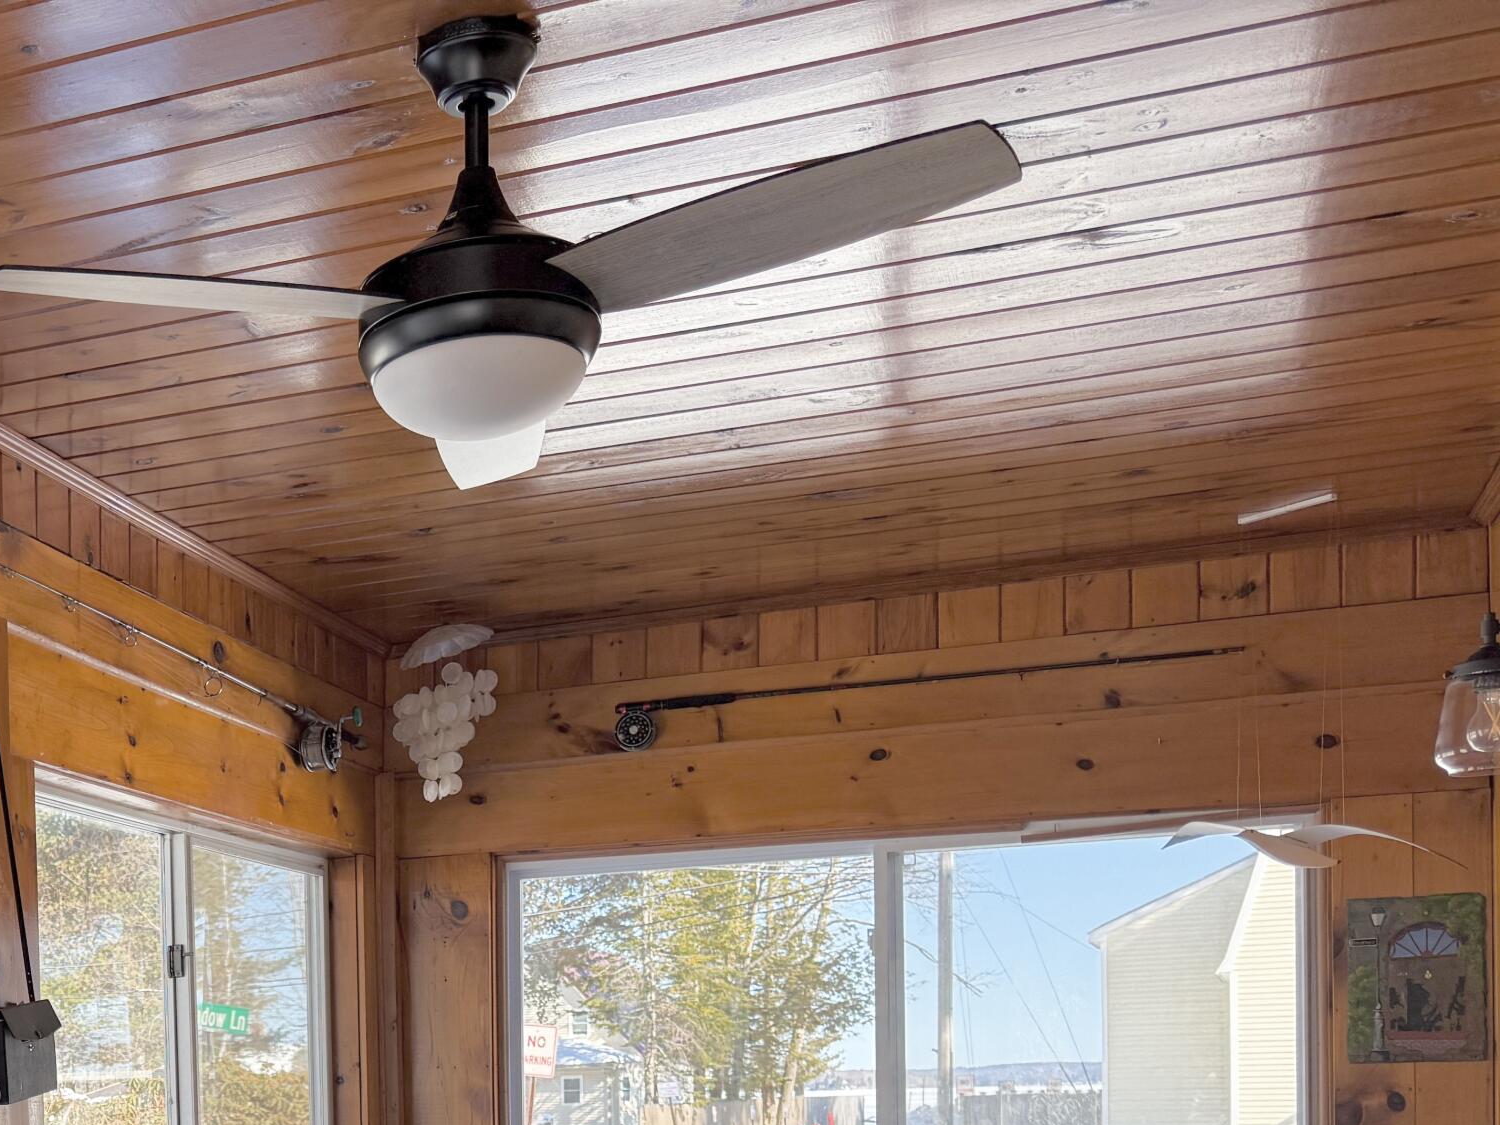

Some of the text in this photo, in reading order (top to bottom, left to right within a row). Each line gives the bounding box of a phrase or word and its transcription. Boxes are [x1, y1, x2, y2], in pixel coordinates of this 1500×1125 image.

[230, 1010, 246, 1031] Ln
[527, 1035, 545, 1048] NO
[524, 1055, 551, 1066] ARKING
